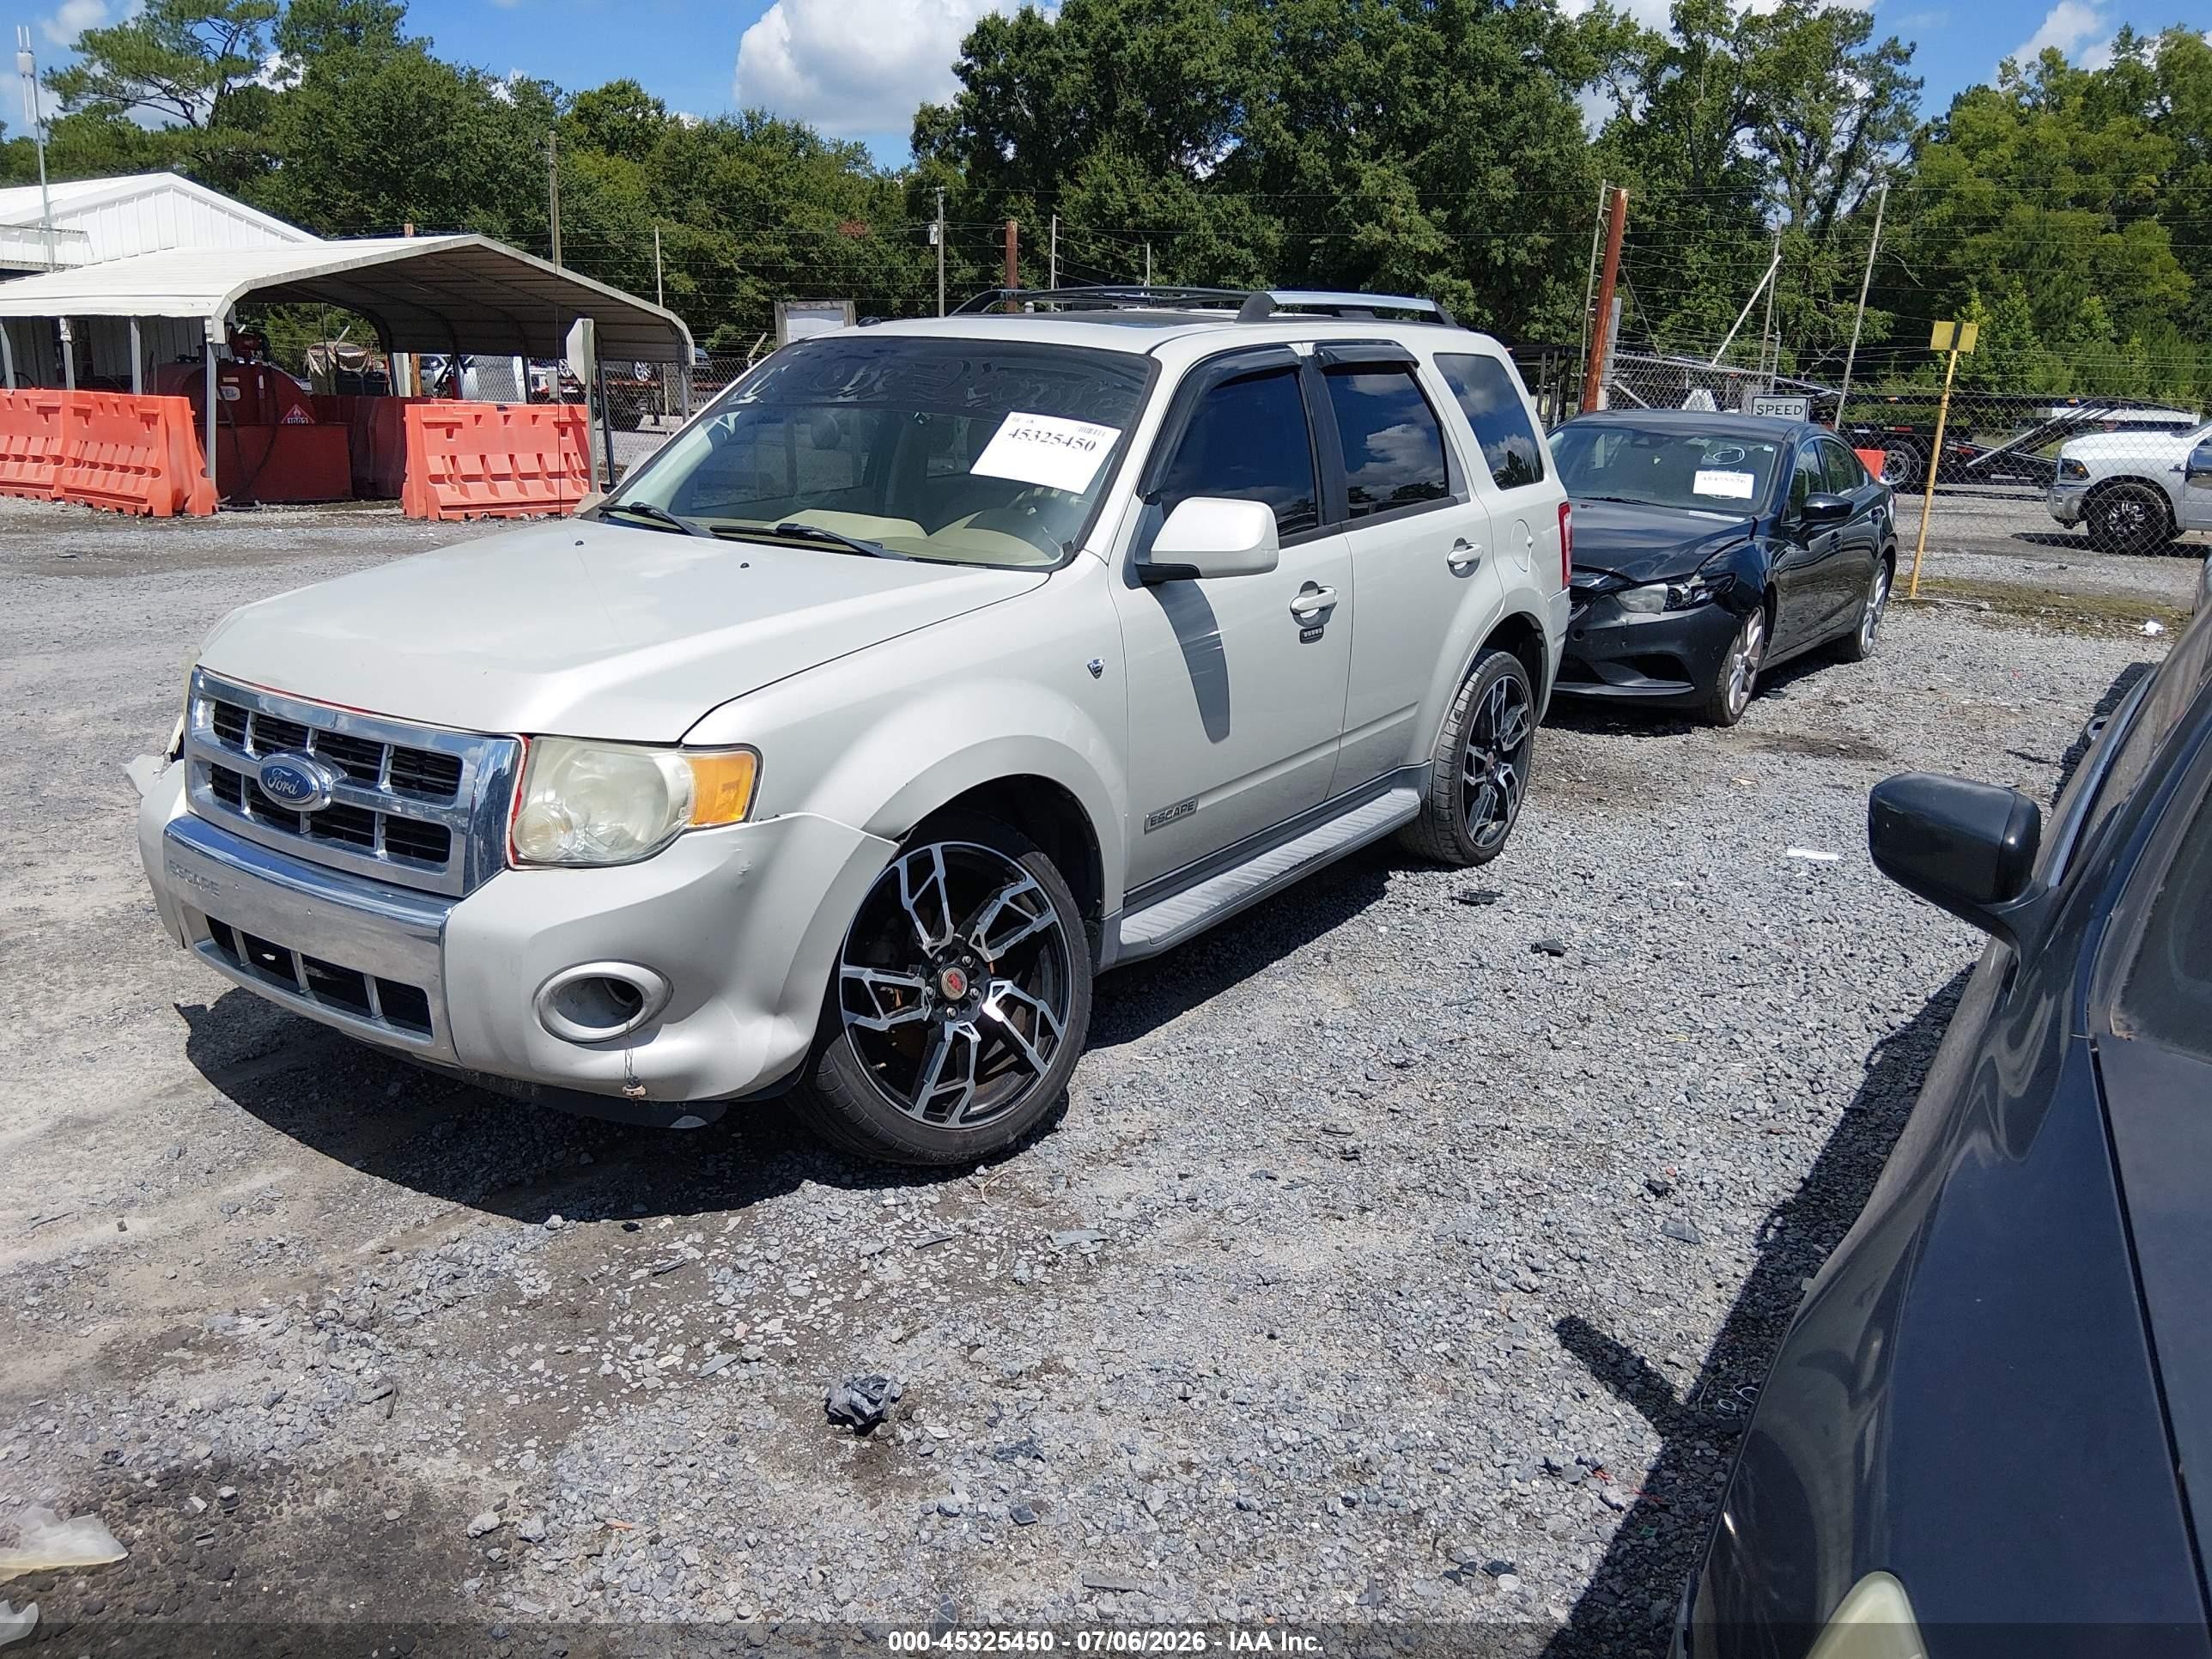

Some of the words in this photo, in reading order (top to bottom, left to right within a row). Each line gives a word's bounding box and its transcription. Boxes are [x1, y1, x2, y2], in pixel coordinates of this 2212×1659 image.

[1756, 404, 1803, 416] SPEED
[1007, 427, 1097, 453] 45325450
[267, 767, 299, 796] Ford
[1150, 799, 1195, 827] ESCAPE
[169, 860, 222, 899] ESCAPE
